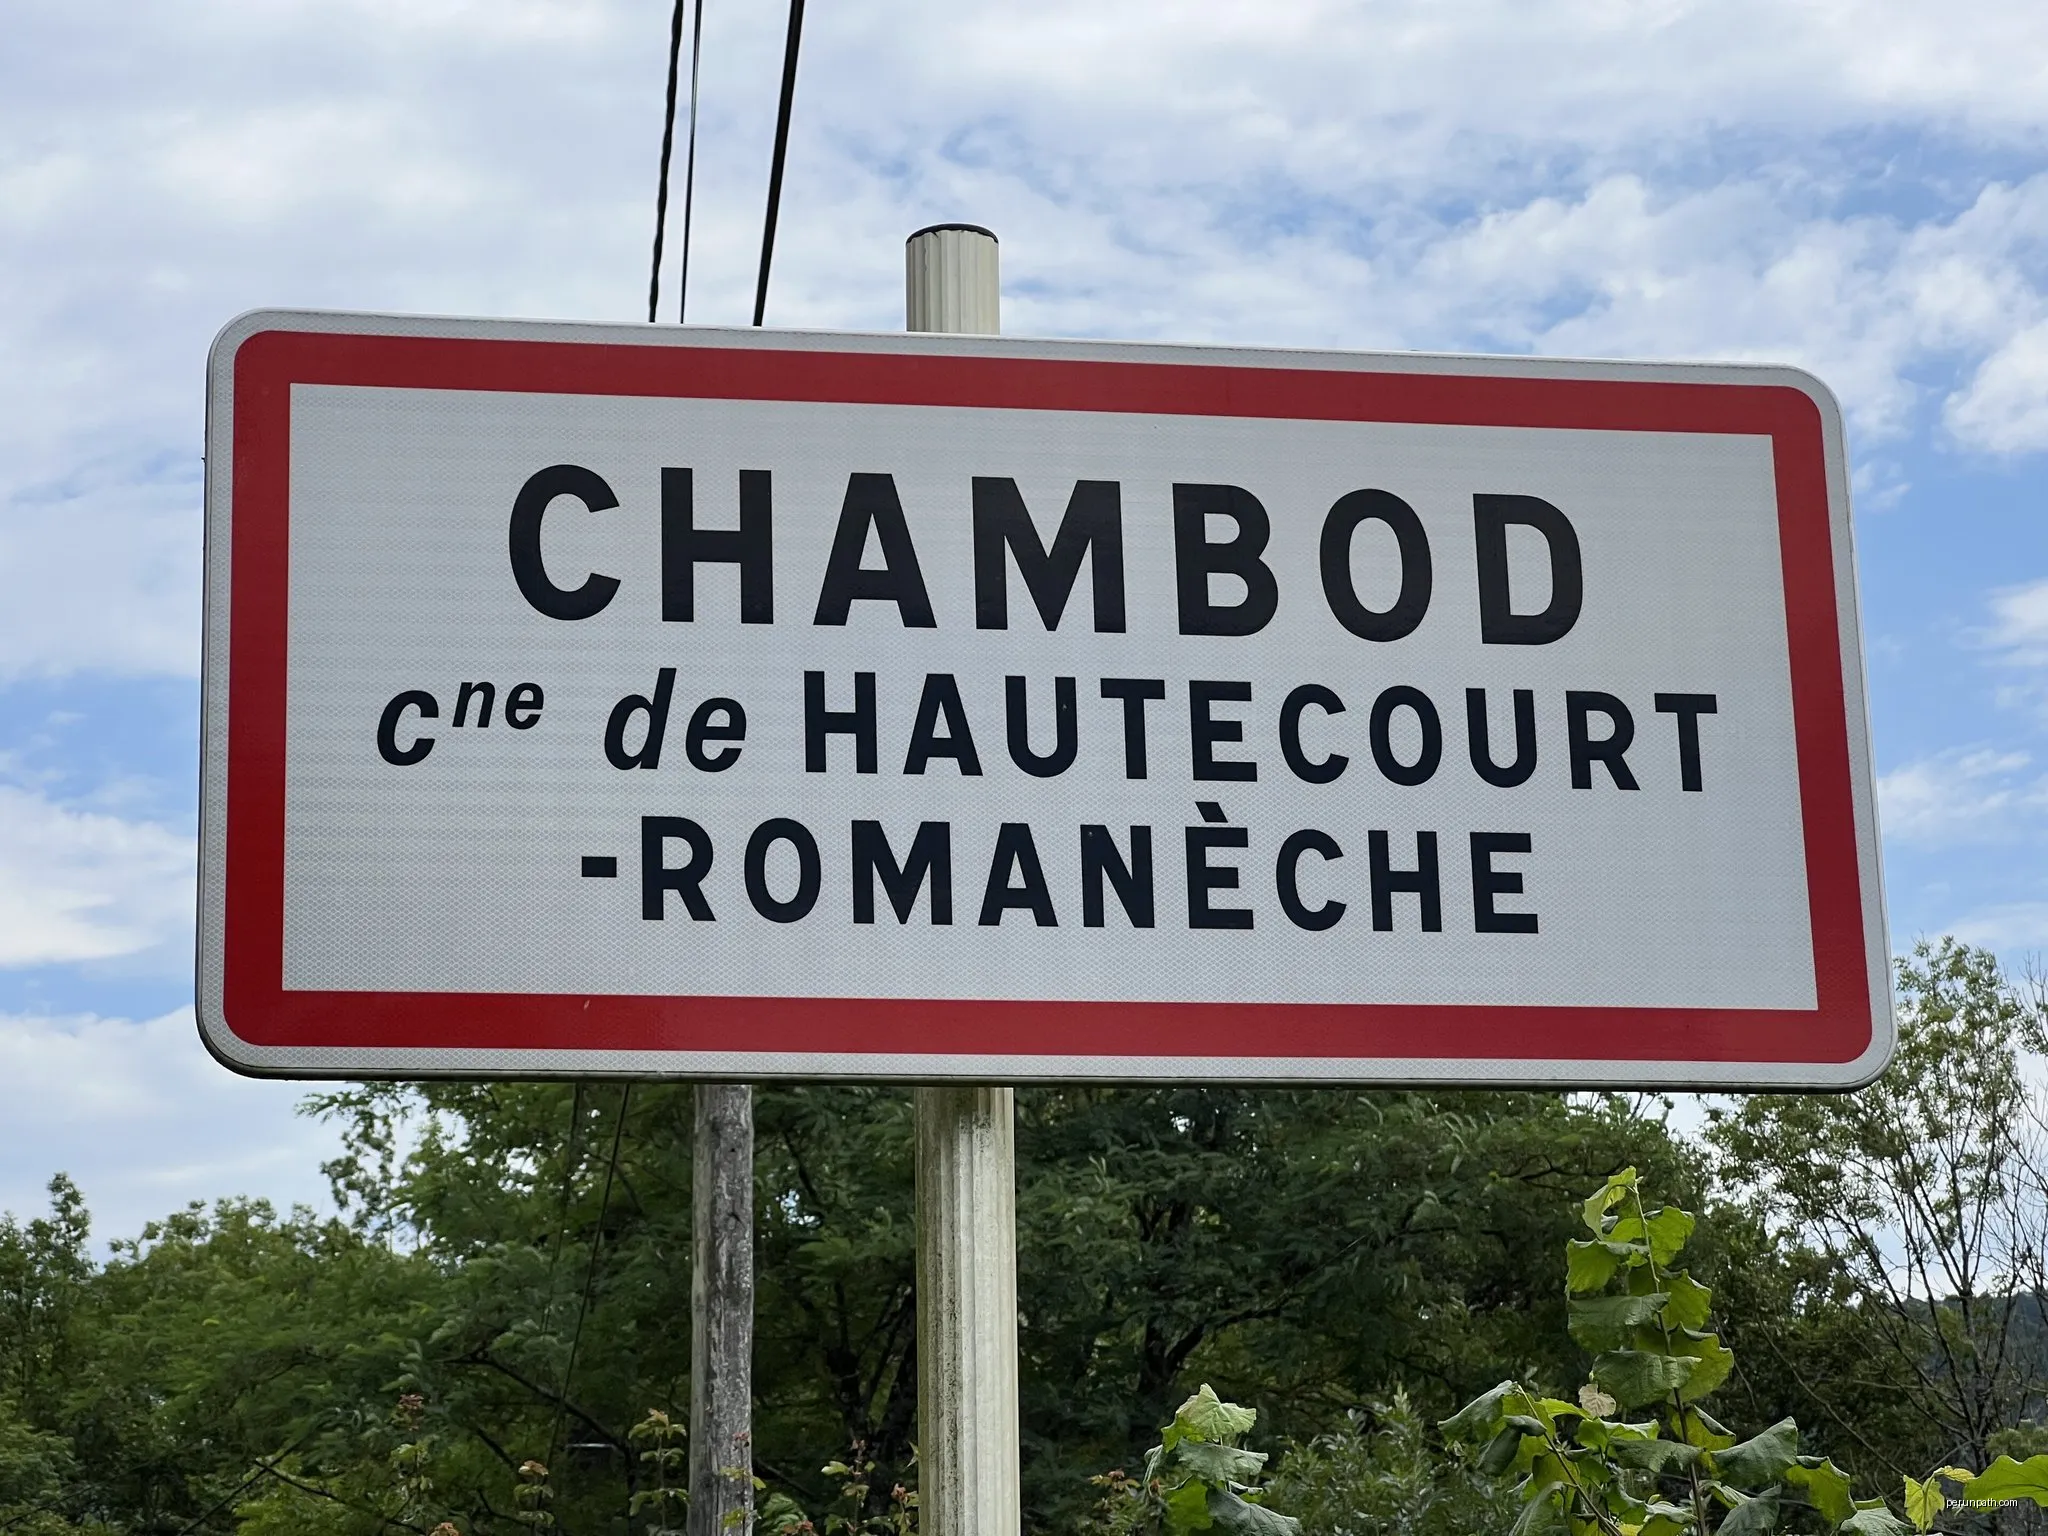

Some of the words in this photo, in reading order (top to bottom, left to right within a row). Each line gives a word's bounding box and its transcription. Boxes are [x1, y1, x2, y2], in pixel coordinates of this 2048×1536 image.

[508, 464, 1584, 646] CHAMBOD
[603, 667, 747, 773] de
[803, 670, 1718, 793] HAUTECOURT
[581, 801, 1539, 935] -ROMANÈCHE
